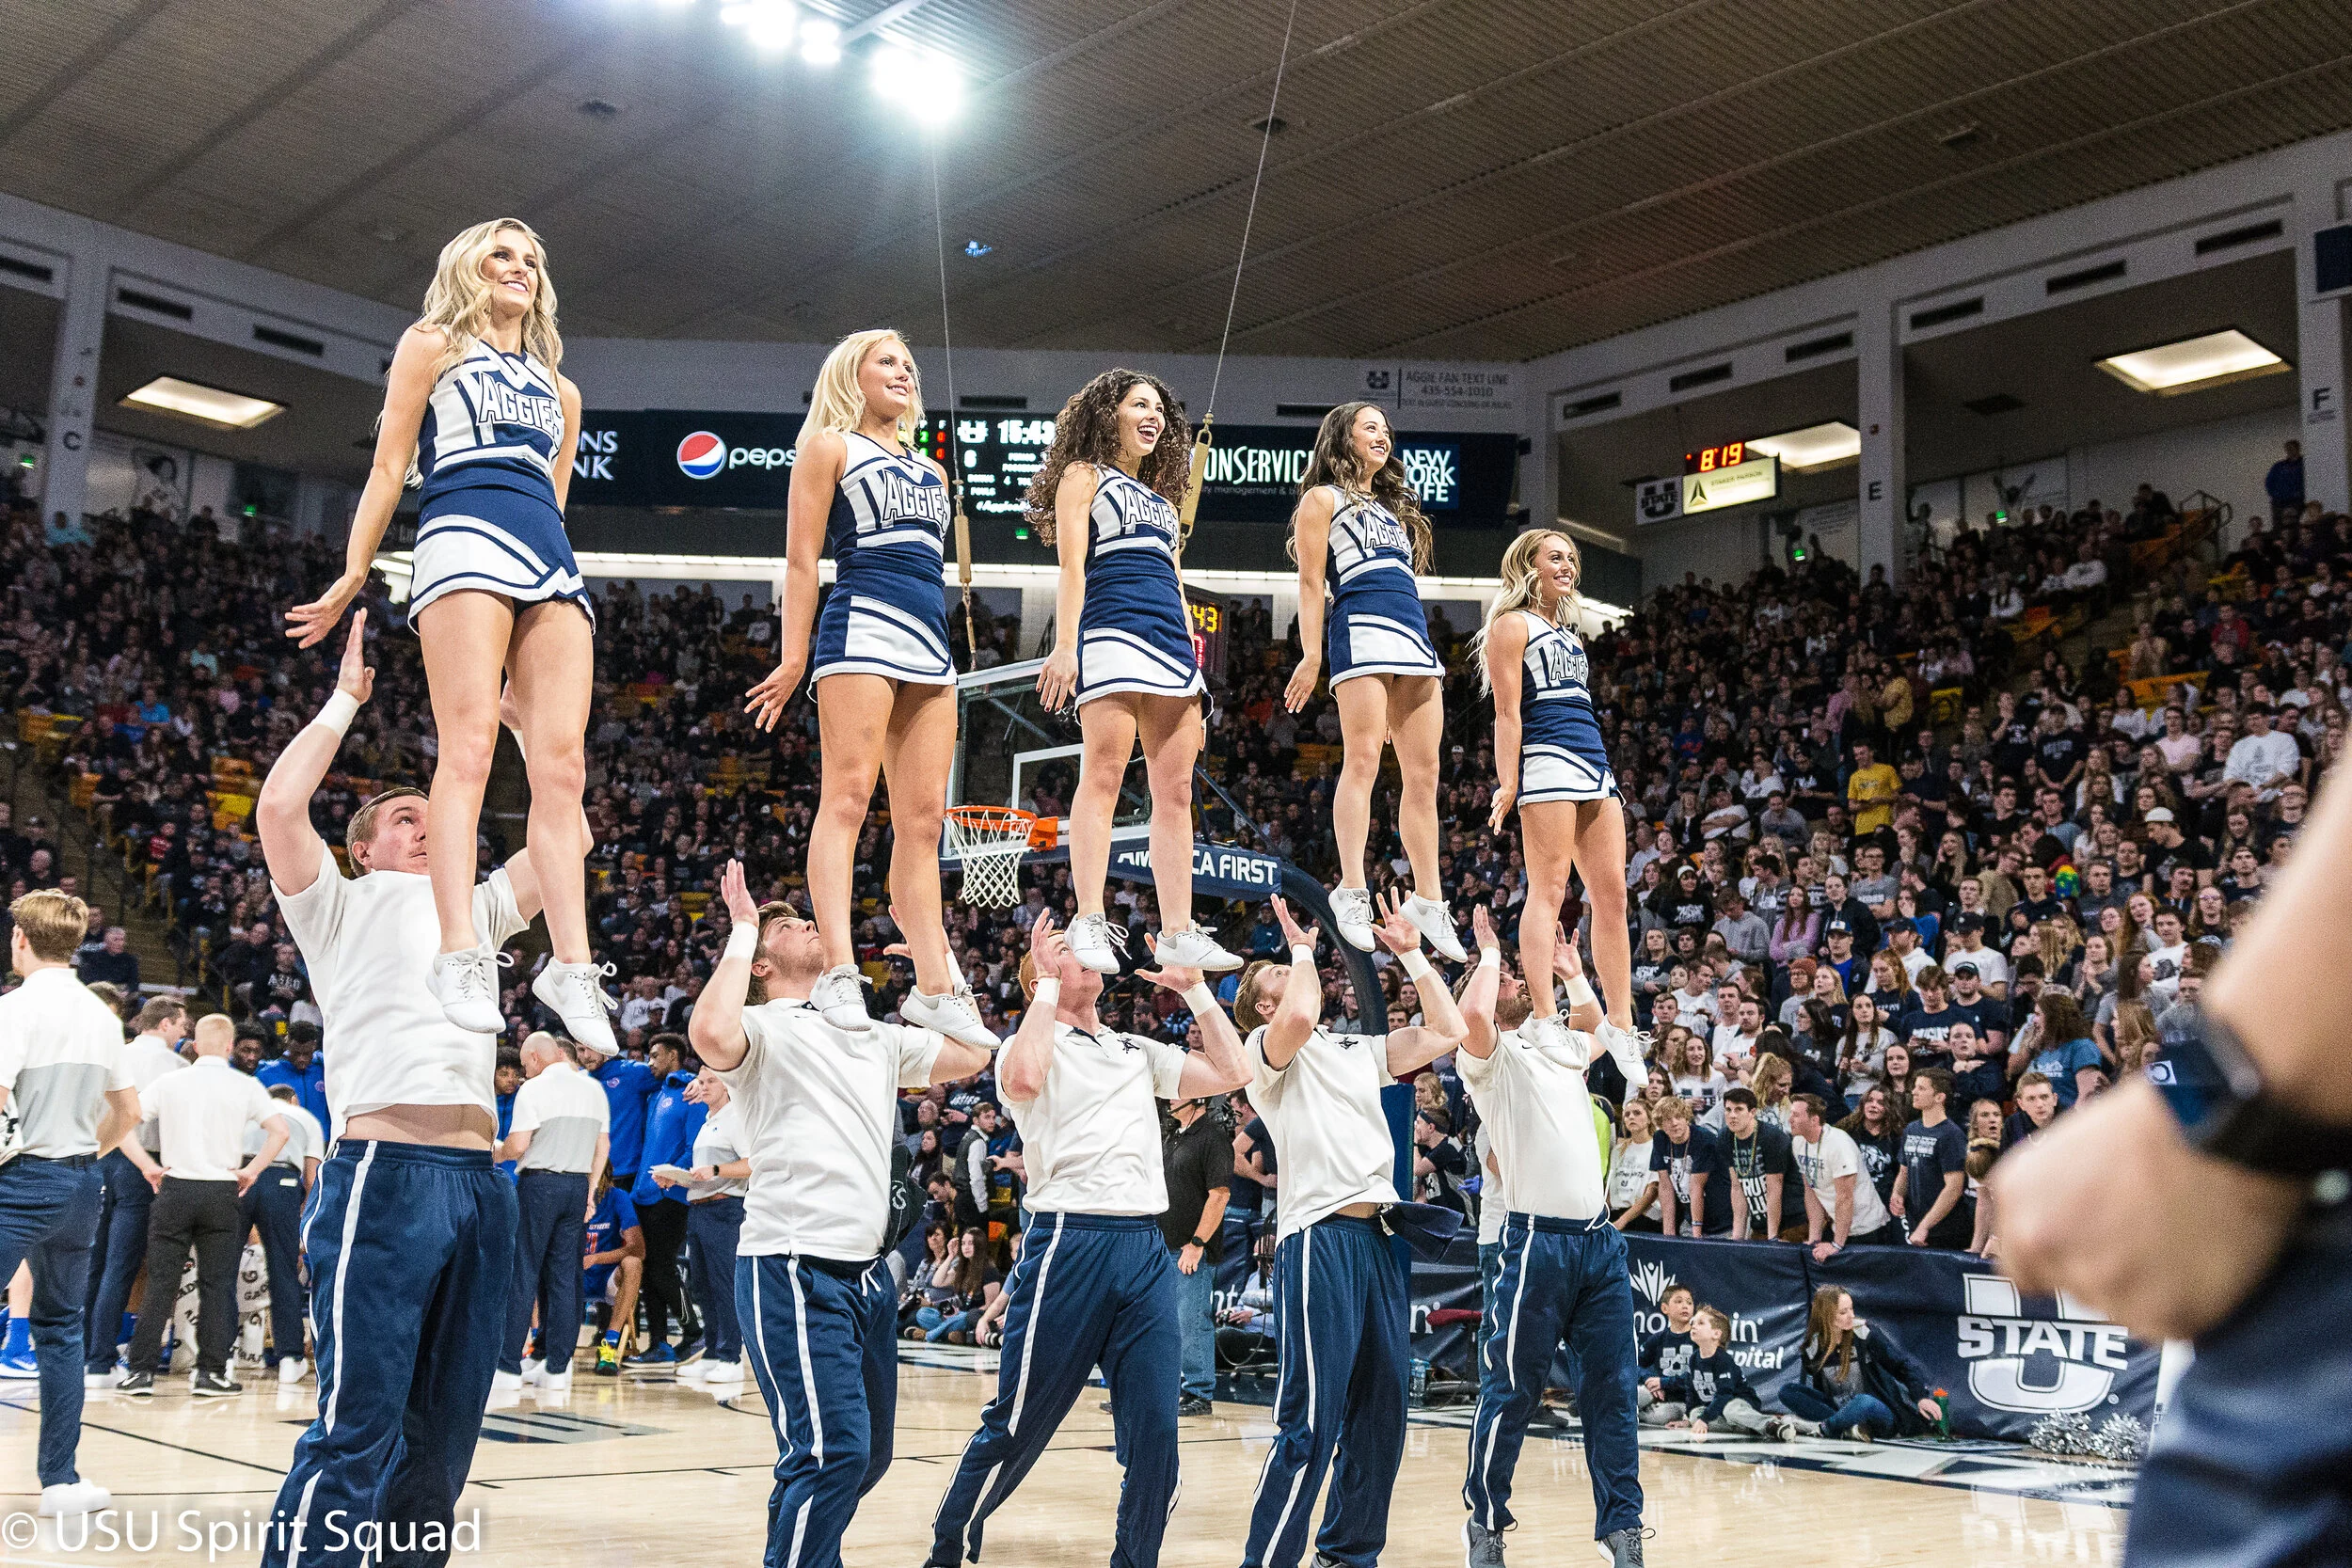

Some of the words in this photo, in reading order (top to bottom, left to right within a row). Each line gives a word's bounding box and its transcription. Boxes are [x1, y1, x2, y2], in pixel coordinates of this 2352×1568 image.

[2313, 387, 2331, 411] F
[476, 372, 564, 451] AGGIES
[63, 431, 83, 451] C
[729, 447, 797, 470] peps
[1403, 449, 1452, 467] NEW
[1406, 466, 1456, 485] ORK
[882, 469, 950, 533] AGGIES
[1405, 482, 1449, 501] IFE
[1868, 481, 1881, 500] E
[1117, 851, 1216, 877] AMCA
[1218, 856, 1278, 885] FIRST
[1958, 1315, 2129, 1370] STATE
